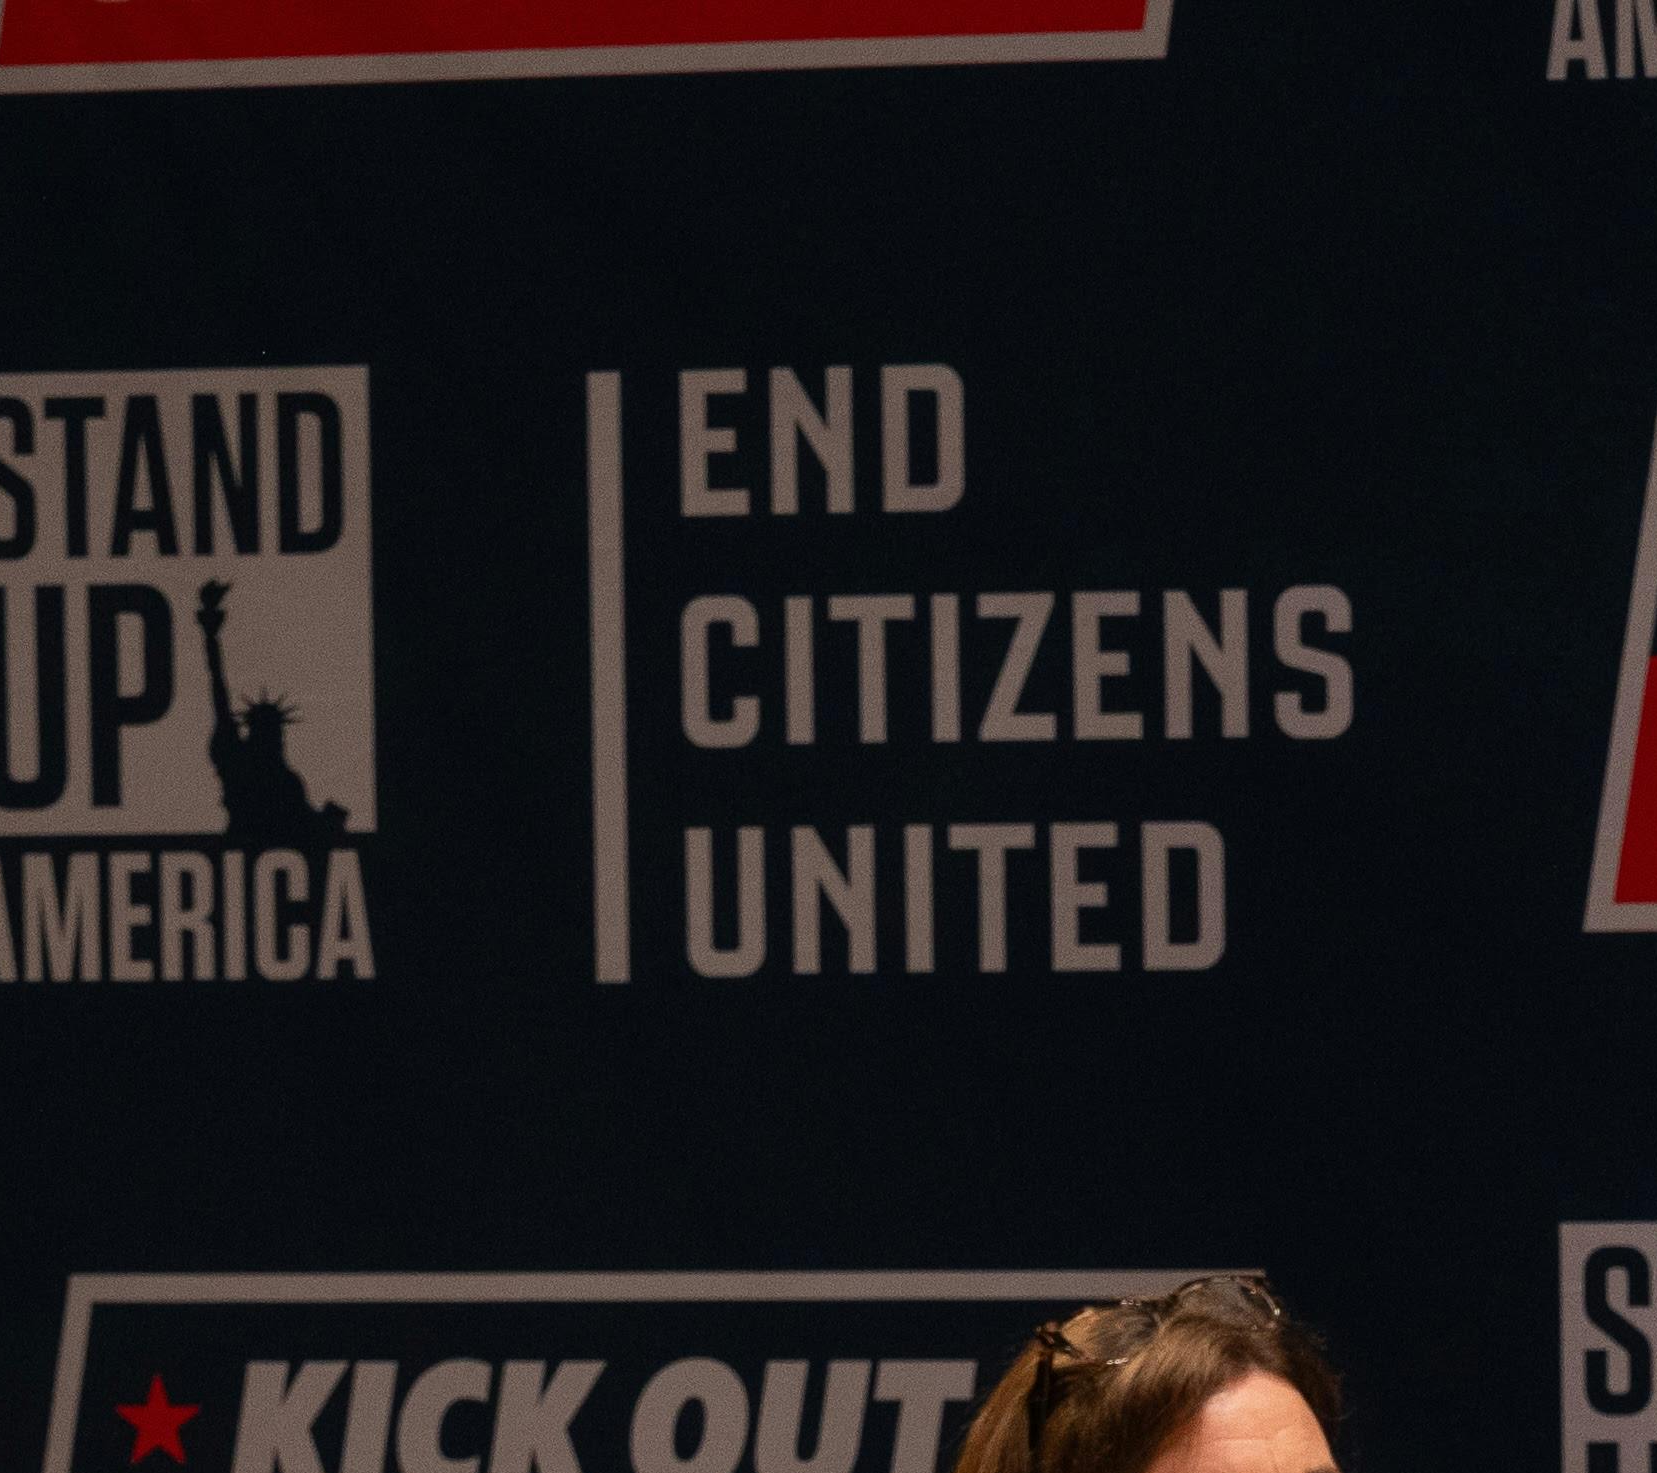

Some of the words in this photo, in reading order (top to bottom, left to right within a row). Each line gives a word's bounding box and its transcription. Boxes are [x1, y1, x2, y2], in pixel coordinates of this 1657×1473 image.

[679, 364, 966, 517] END
[680, 585, 1354, 748] CITIZENS
[685, 821, 1226, 978] UNITED
